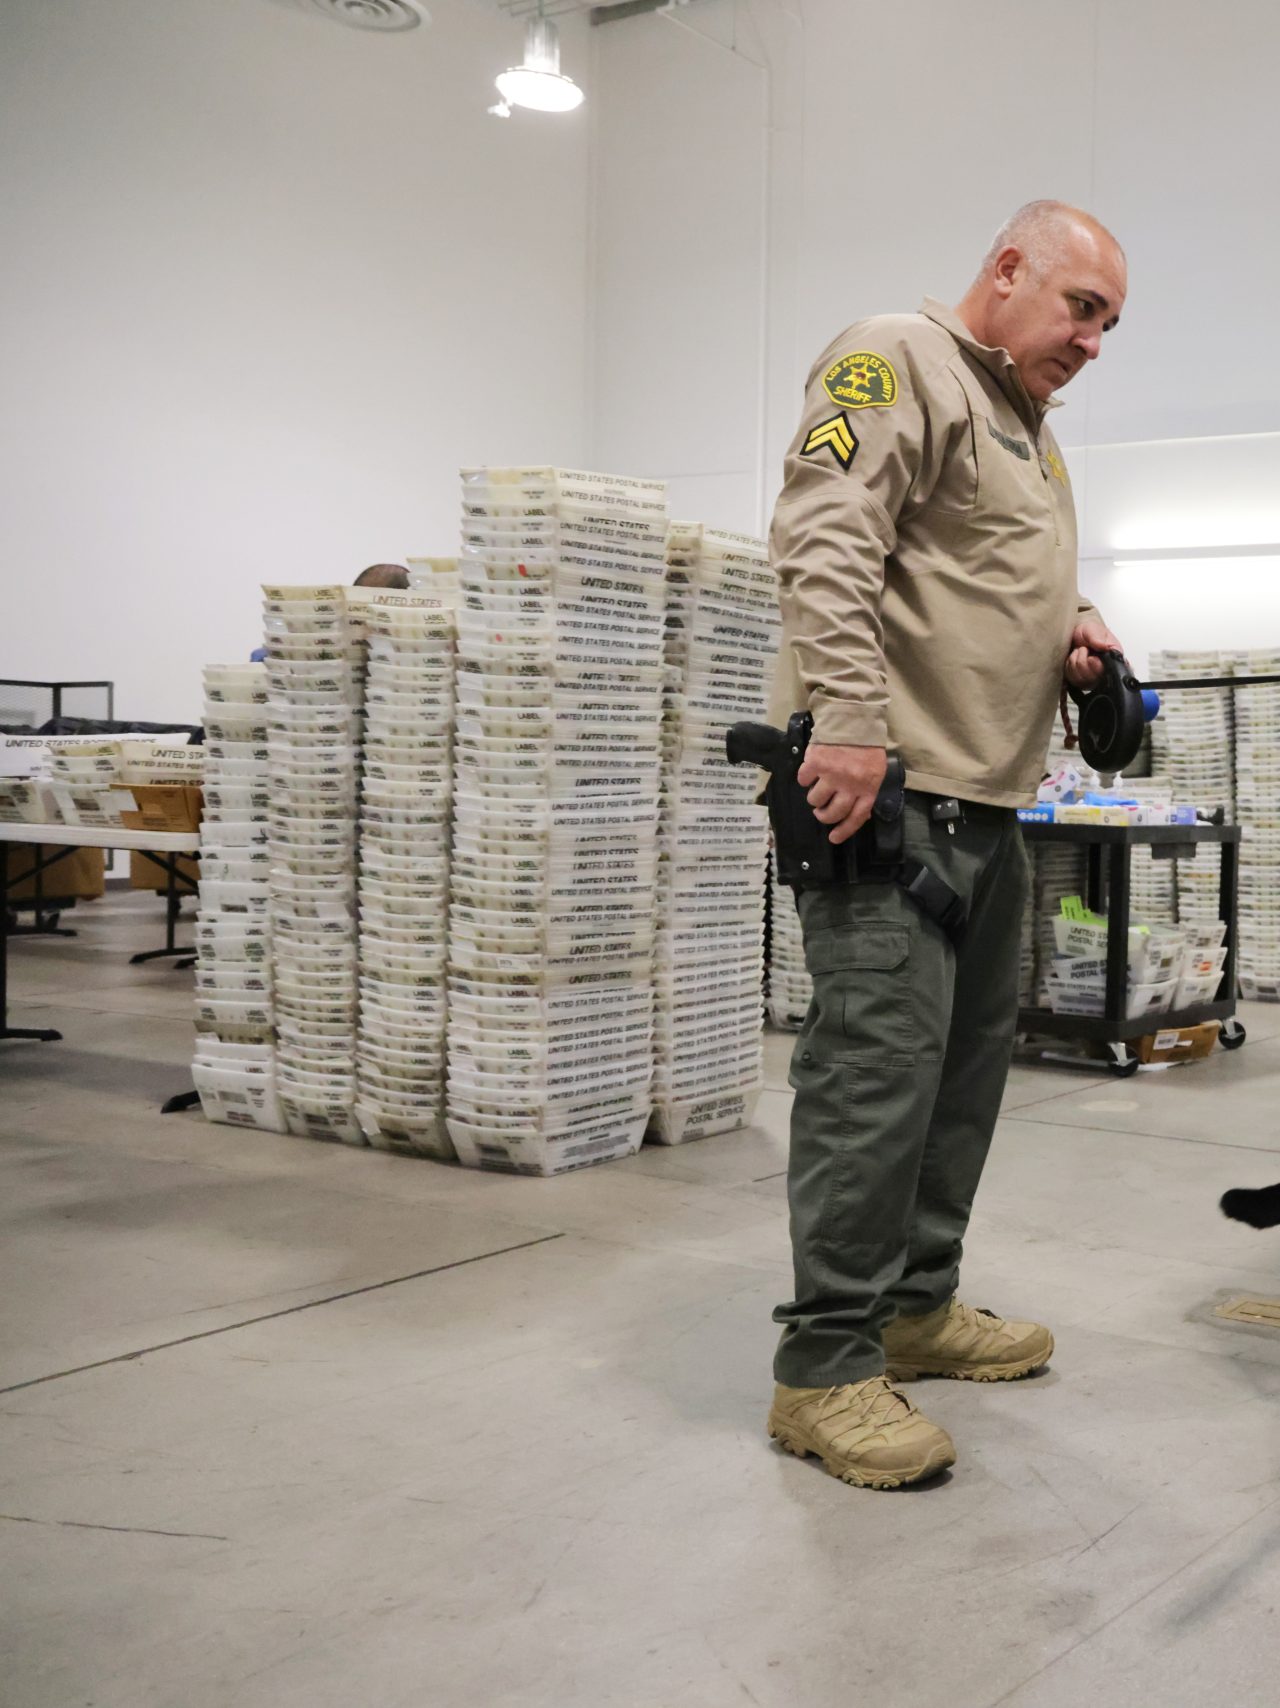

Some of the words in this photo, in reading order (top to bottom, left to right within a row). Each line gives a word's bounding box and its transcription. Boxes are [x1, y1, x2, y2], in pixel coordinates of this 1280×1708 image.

[827, 366, 842, 381] LOS
[843, 356, 881, 368] ANGELES
[879, 368, 892, 401] COUNTY
[833, 386, 872, 402] SHERIFF
[560, 472, 587, 481] UNITED
[588, 475, 613, 484] STATES
[615, 479, 639, 488] POSTAL
[641, 481, 664, 491] SERVICE
[562, 490, 587, 500] UNITED
[590, 493, 615, 503] STATES
[616, 498, 639, 508] POSTAL
[641, 502, 665, 511] SERVICE
[560, 556, 586, 565] UNITED
[588, 559, 613, 568] STATES
[615, 563, 638, 573] POSTAL
[640, 566, 663, 575] SERVICE
[722, 568, 749, 580] UNITED
[750, 573, 775, 584] STATES
[581, 576, 612, 589] UNITED
[614, 581, 645, 594] STATES
[373, 595, 407, 606] UNITED
[409, 598, 442, 608] STATES
[558, 603, 584, 612] UNITED
[586, 606, 611, 616] STATES
[613, 611, 636, 620] POSTAL
[638, 614, 661, 622] SERVICE
[556, 620, 582, 628] UNITED
[584, 622, 609, 631] STATES
[610, 624, 634, 633] POSTAL
[713, 626, 743, 638] UNITED
[743, 631, 770, 642] STATES
[559, 636, 583, 644] UNITED
[585, 638, 610, 647] STATES
[611, 641, 635, 649] POSTAL
[637, 643, 660, 651] SERVICE
[556, 654, 582, 662] UNITED
[583, 656, 608, 664] STATES
[610, 658, 633, 666] POSTAL
[635, 659, 658, 667] SERVICE
[711, 654, 739, 664] UNITED
[739, 658, 765, 667] STATES
[6, 740, 43, 748] UNITED
[152, 750, 185, 759] UNITED
[157, 761, 184, 769] STATES
[606, 800, 629, 808] POSTAL
[631, 798, 654, 806] SERVICE
[581, 817, 606, 825] STATES
[607, 816, 631, 824] POSTAL
[633, 814, 655, 822] SERVICE
[1071, 927, 1095, 937] UNITED
[1067, 935, 1093, 946] POSTAL
[570, 945, 601, 955] UNITED
[1072, 962, 1098, 970] UNITED
[569, 974, 600, 984] UNITED
[603, 971, 632, 979] STATES
[1071, 970, 1098, 979] POSTAL
[1086, 984, 1106, 992] POST
[575, 998, 599, 1007] STATES
[601, 996, 624, 1004] POSTAL
[626, 993, 649, 1001] SERVICE
[548, 1045, 573, 1054] UNITED
[575, 1042, 599, 1051] STATES
[625, 1033, 649, 1042] SERVICE
[547, 1076, 573, 1086] UNITED
[575, 1071, 599, 1082] STATES
[600, 1068, 624, 1076] POSTAL
[626, 1063, 648, 1072] SERVICE
[548, 1091, 573, 1101] UNITED
[575, 1086, 600, 1096] STATES
[601, 1082, 624, 1091] POSTAL
[626, 1075, 648, 1084] SERVICE
[691, 1101, 717, 1115] UNITED
[718, 1095, 744, 1108] STATES
[686, 1112, 713, 1126] POSTAL
[716, 1104, 745, 1119] SERVICE
